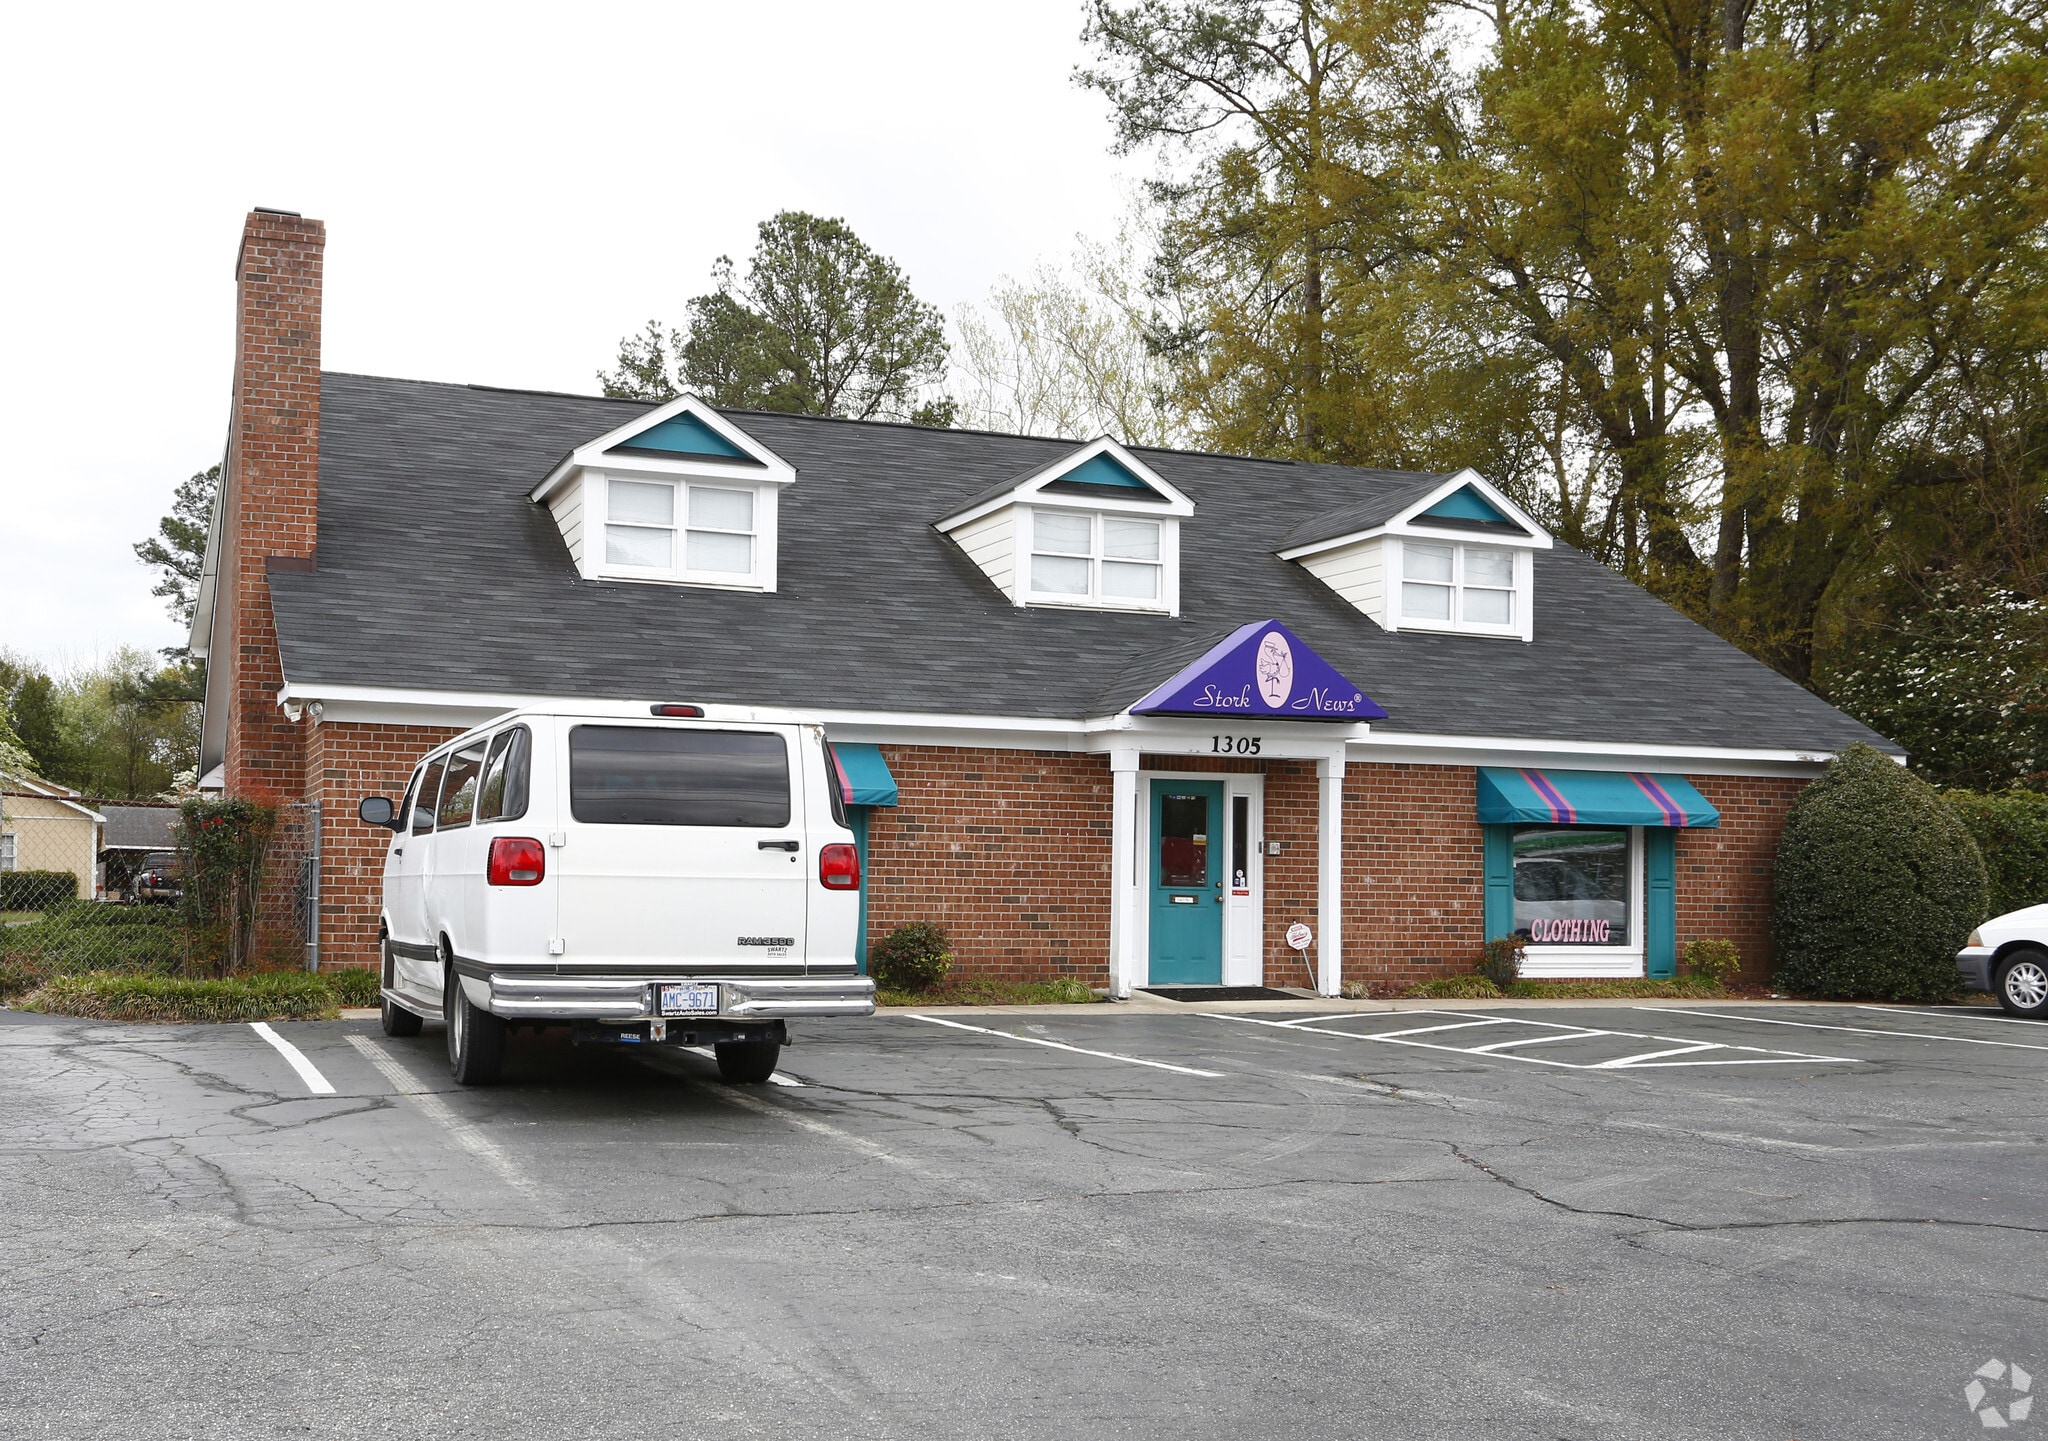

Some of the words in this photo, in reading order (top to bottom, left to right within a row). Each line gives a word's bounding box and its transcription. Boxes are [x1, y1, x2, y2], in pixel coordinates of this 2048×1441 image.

[1193, 684, 1251, 708] Stork
[1211, 735, 1262, 755] 1305
[1531, 918, 1610, 943] CLOTHING
[662, 991, 716, 1008] AMC-9671
